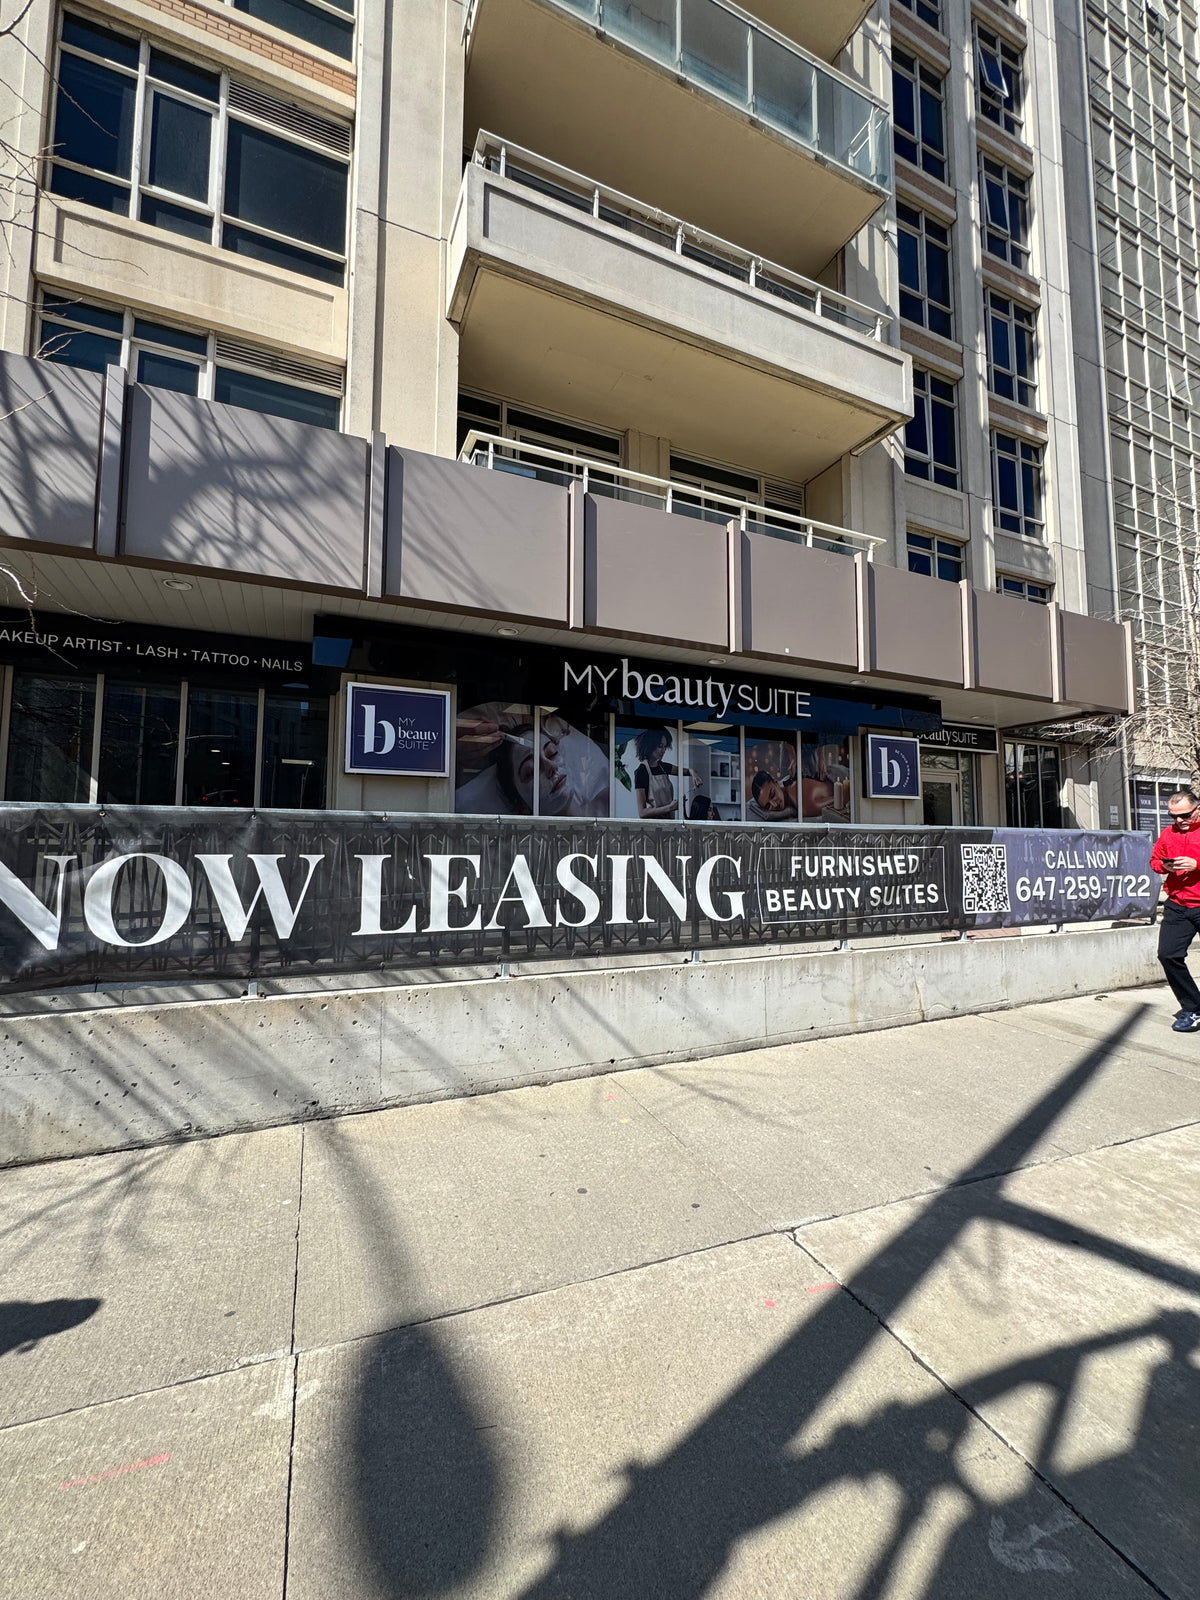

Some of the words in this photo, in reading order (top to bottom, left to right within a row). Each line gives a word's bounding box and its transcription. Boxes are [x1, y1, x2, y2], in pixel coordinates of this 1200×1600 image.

[62, 636, 123, 653] ARTIST
[136, 643, 179, 659] LASH
[191, 649, 250, 666] TATTOO
[261, 657, 303, 672] NAILS
[398, 717, 416, 726] MY
[398, 726, 439, 744] beauty
[398, 739, 430, 750] SUITE
[790, 854, 920, 878] FURNISHED
[1044, 849, 1085, 870] CALL
[1087, 850, 1120, 869] NOW
[765, 886, 862, 912] BEAUTY
[869, 883, 940, 907] SUITES
[1015, 874, 1152, 902] 647-259-7722
[0, 852, 326, 951] NOW
[351, 852, 746, 936] LEASING
